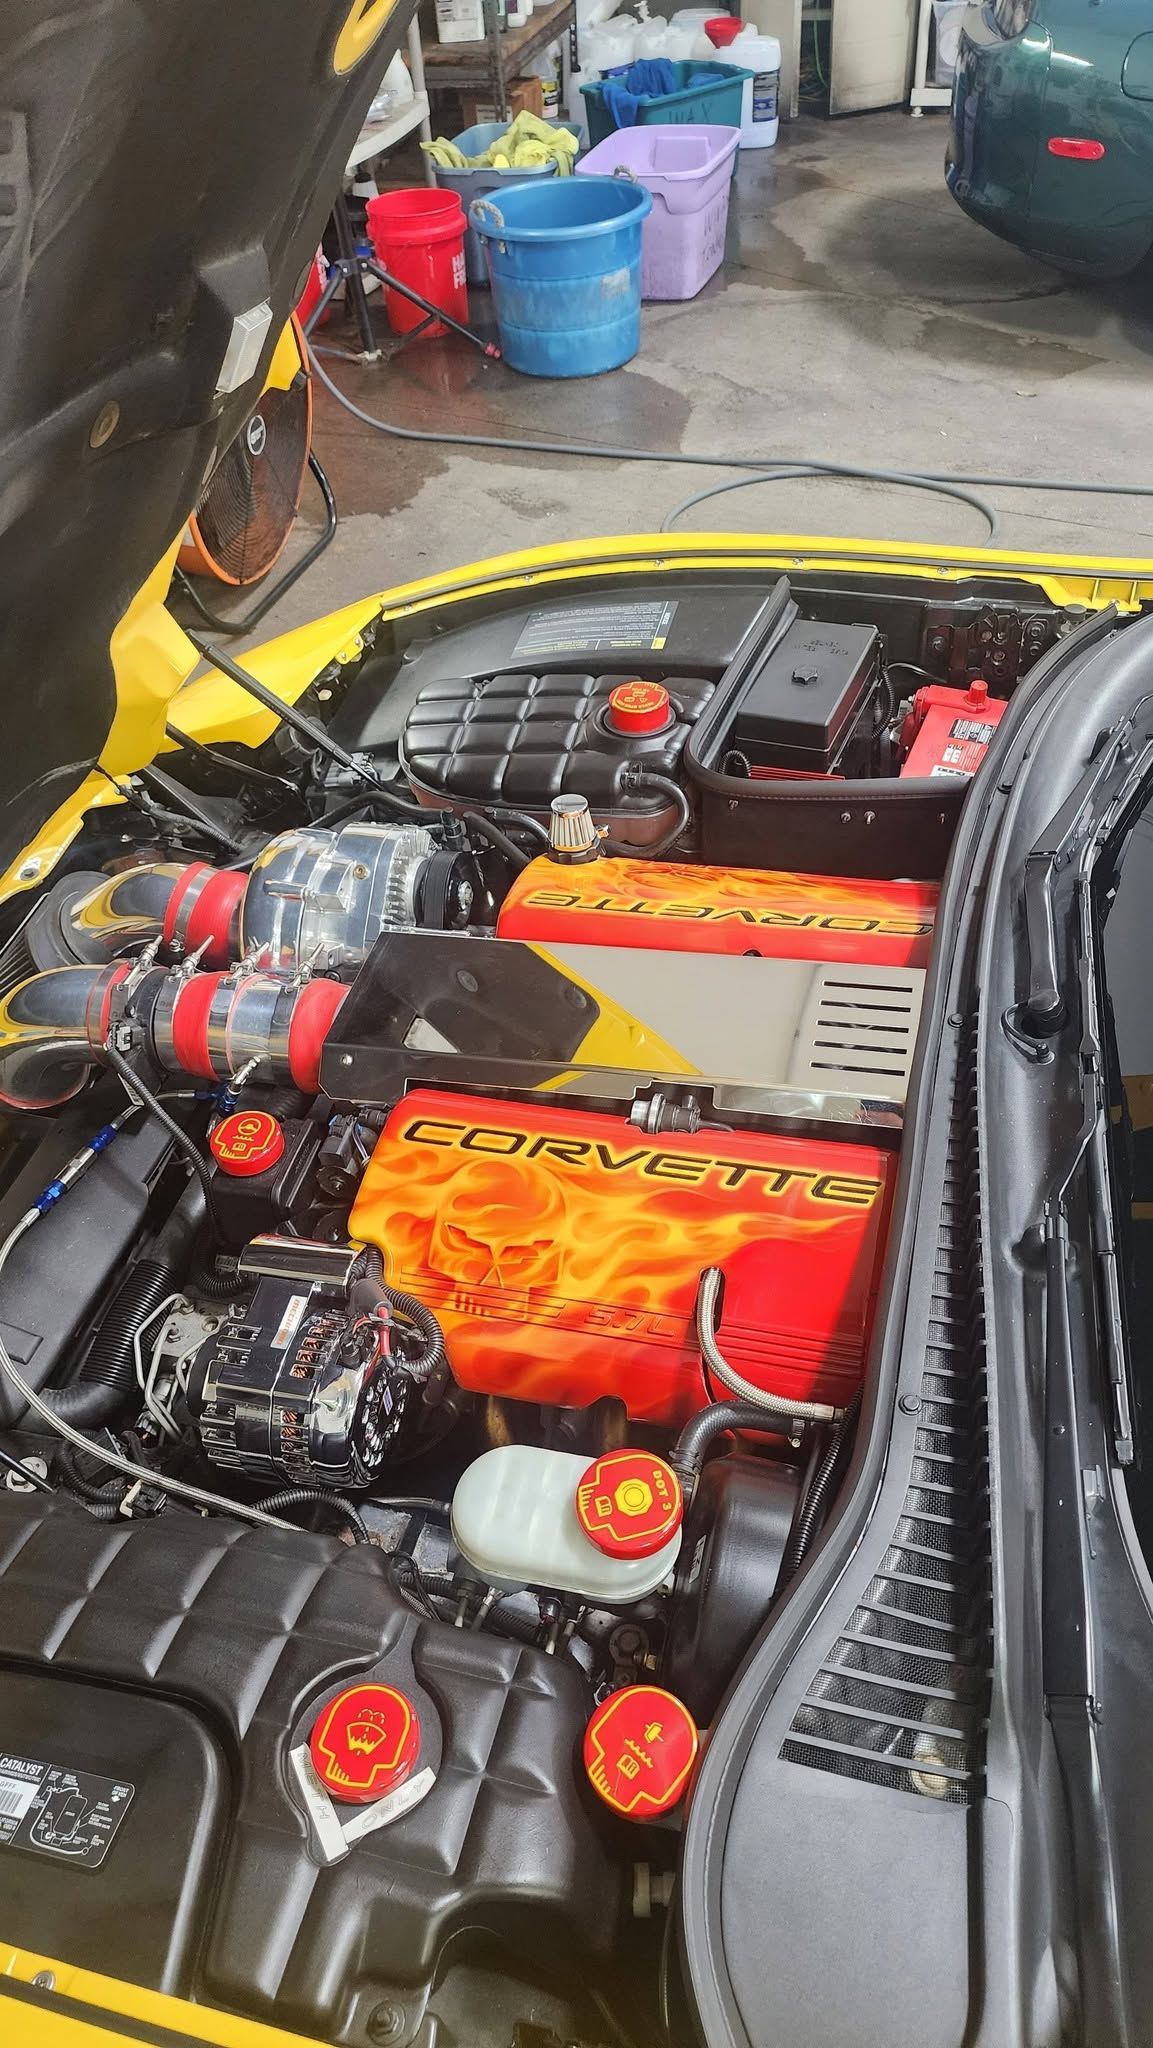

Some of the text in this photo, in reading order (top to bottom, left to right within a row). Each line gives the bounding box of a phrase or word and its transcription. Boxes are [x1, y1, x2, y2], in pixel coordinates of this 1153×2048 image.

[527, 891, 934, 936] CORVETTE
[404, 1119, 882, 1205] CORVETTE
[584, 1303, 675, 1338] 5.7L
[652, 1469, 673, 1511] DOT 3
[0, 1757, 44, 1776] CATALYST
